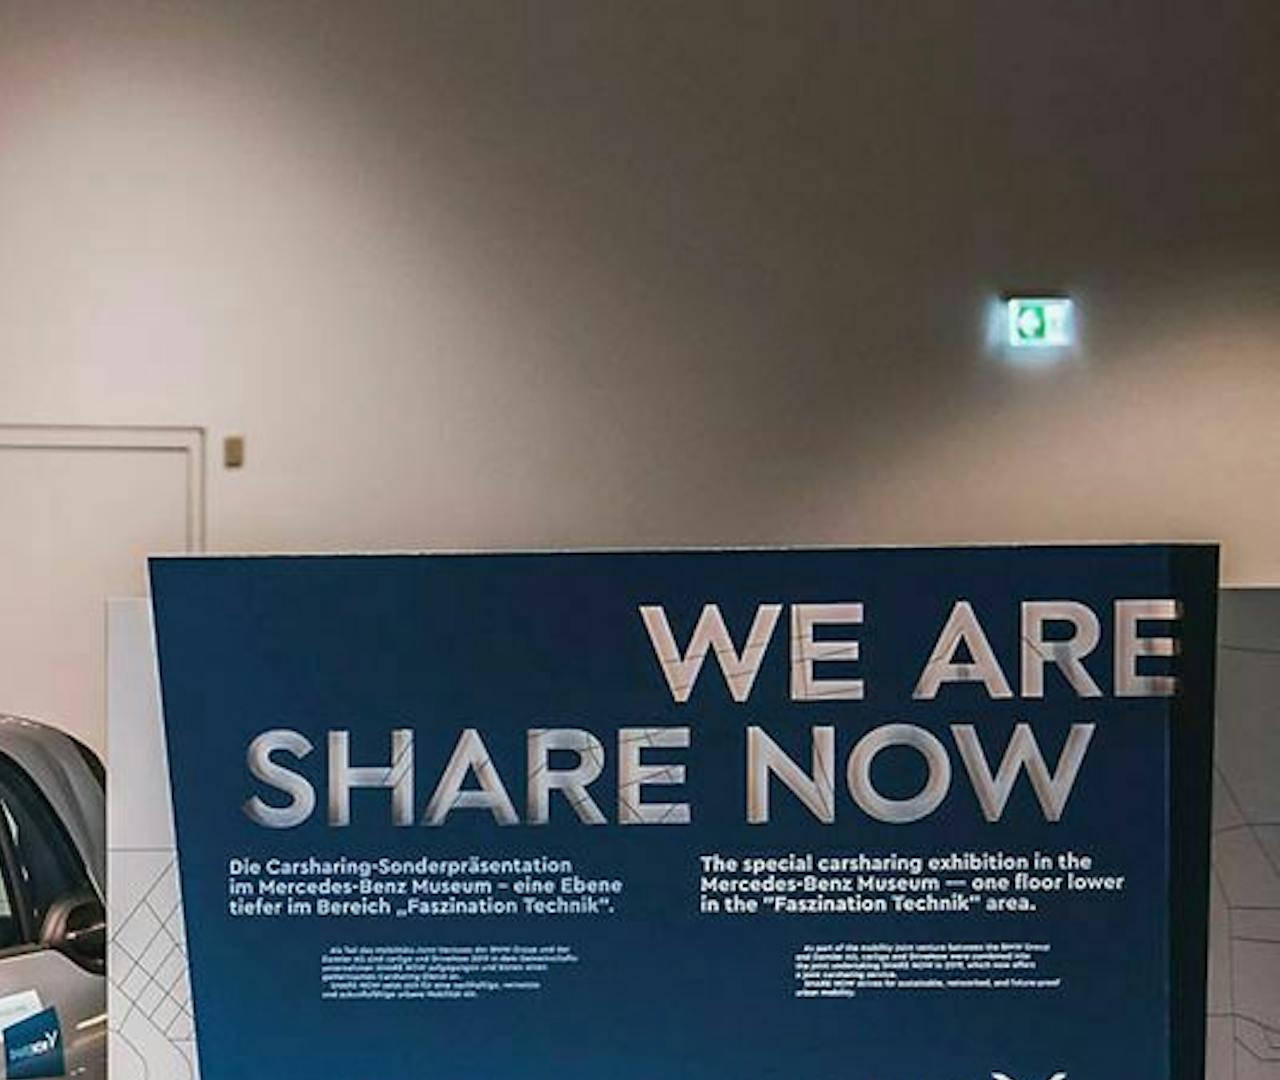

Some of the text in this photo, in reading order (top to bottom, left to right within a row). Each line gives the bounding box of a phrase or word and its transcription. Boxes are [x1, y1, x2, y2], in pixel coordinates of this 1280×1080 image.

[640, 599, 1178, 703] WE ARE
[246, 723, 1096, 828] SHARE NOW
[229, 856, 572, 878] Die Carsharing-Sonderpräsentation
[700, 852, 1092, 875] The special carsharing exhibition in the
[229, 879, 254, 895] im
[258, 878, 407, 895] Mercedes-Benz
[412, 877, 492, 894] Museum
[513, 877, 555, 893] eine
[561, 876, 623, 893] Ebene
[700, 876, 852, 893] Mercedes-Benz
[856, 875, 940, 892] Museum
[971, 877, 1010, 891] one
[1014, 873, 1063, 891] floor
[1067, 873, 1125, 891] lower
[229, 898, 282, 915] tiefer
[287, 898, 312, 915] im
[316, 897, 391, 915] Bereich
[396, 896, 518, 916] „Faszination
[700, 896, 720, 913] in
[724, 896, 759, 913] the
[985, 897, 1037, 912] area.
